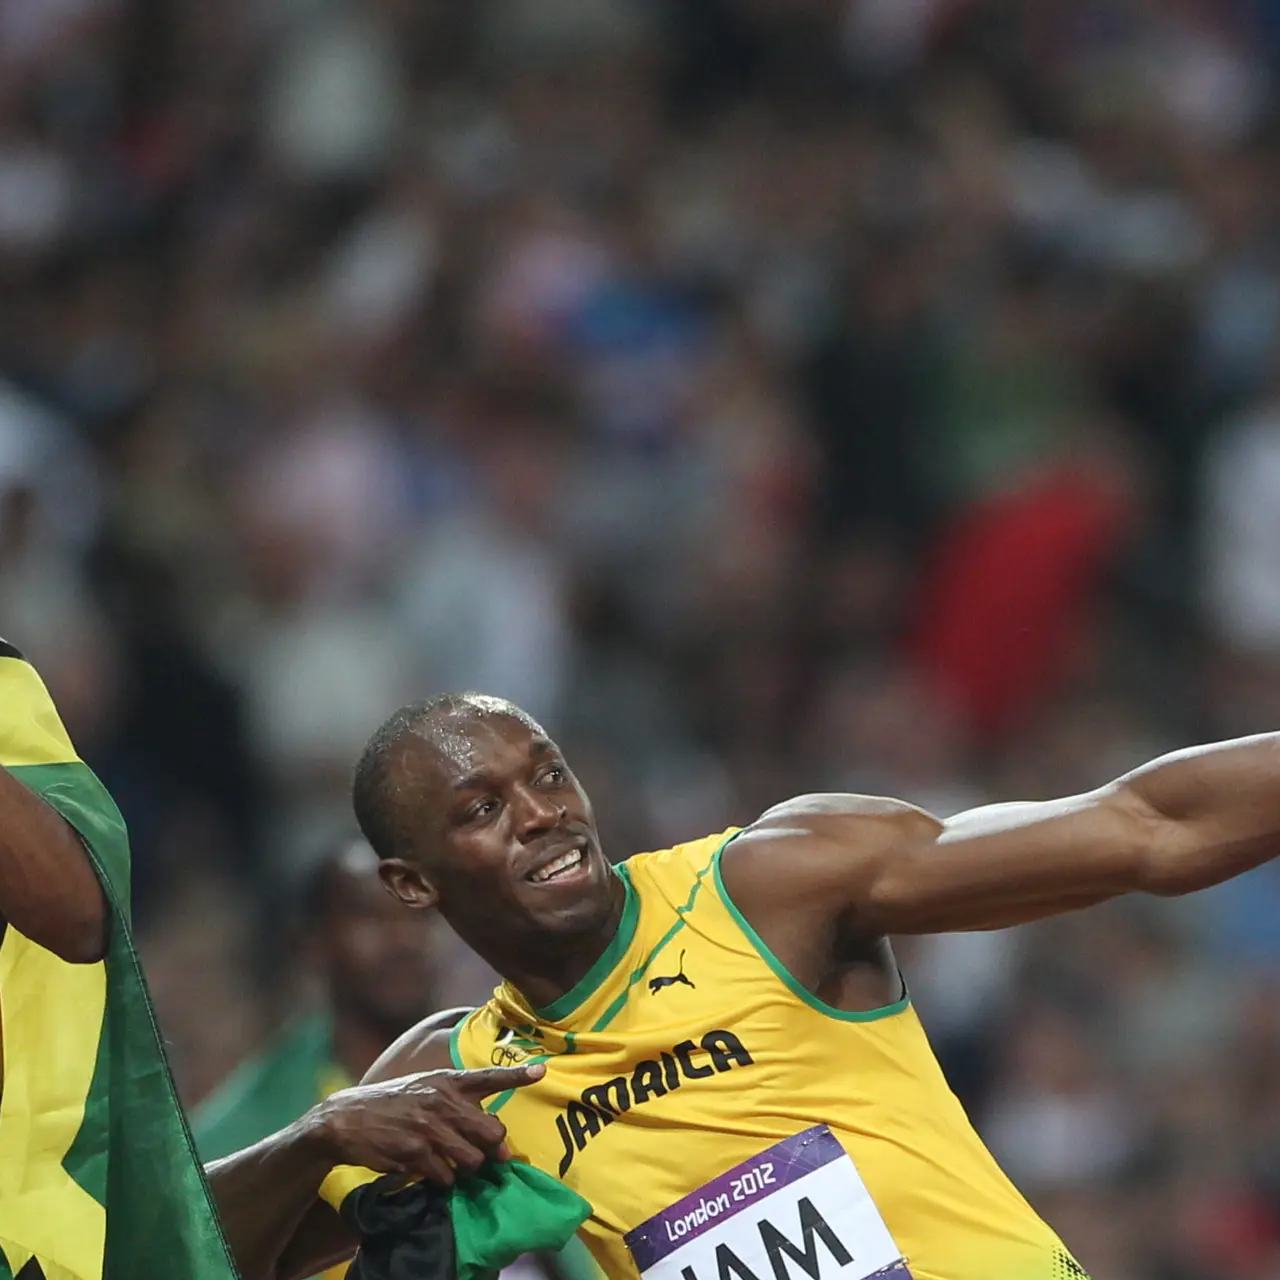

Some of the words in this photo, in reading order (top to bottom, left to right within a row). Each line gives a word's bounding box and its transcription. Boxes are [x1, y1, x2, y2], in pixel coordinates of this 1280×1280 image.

[555, 1029, 755, 1179] JAMAICA
[665, 1192, 731, 1242] London
[730, 1162, 777, 1202] 2012
